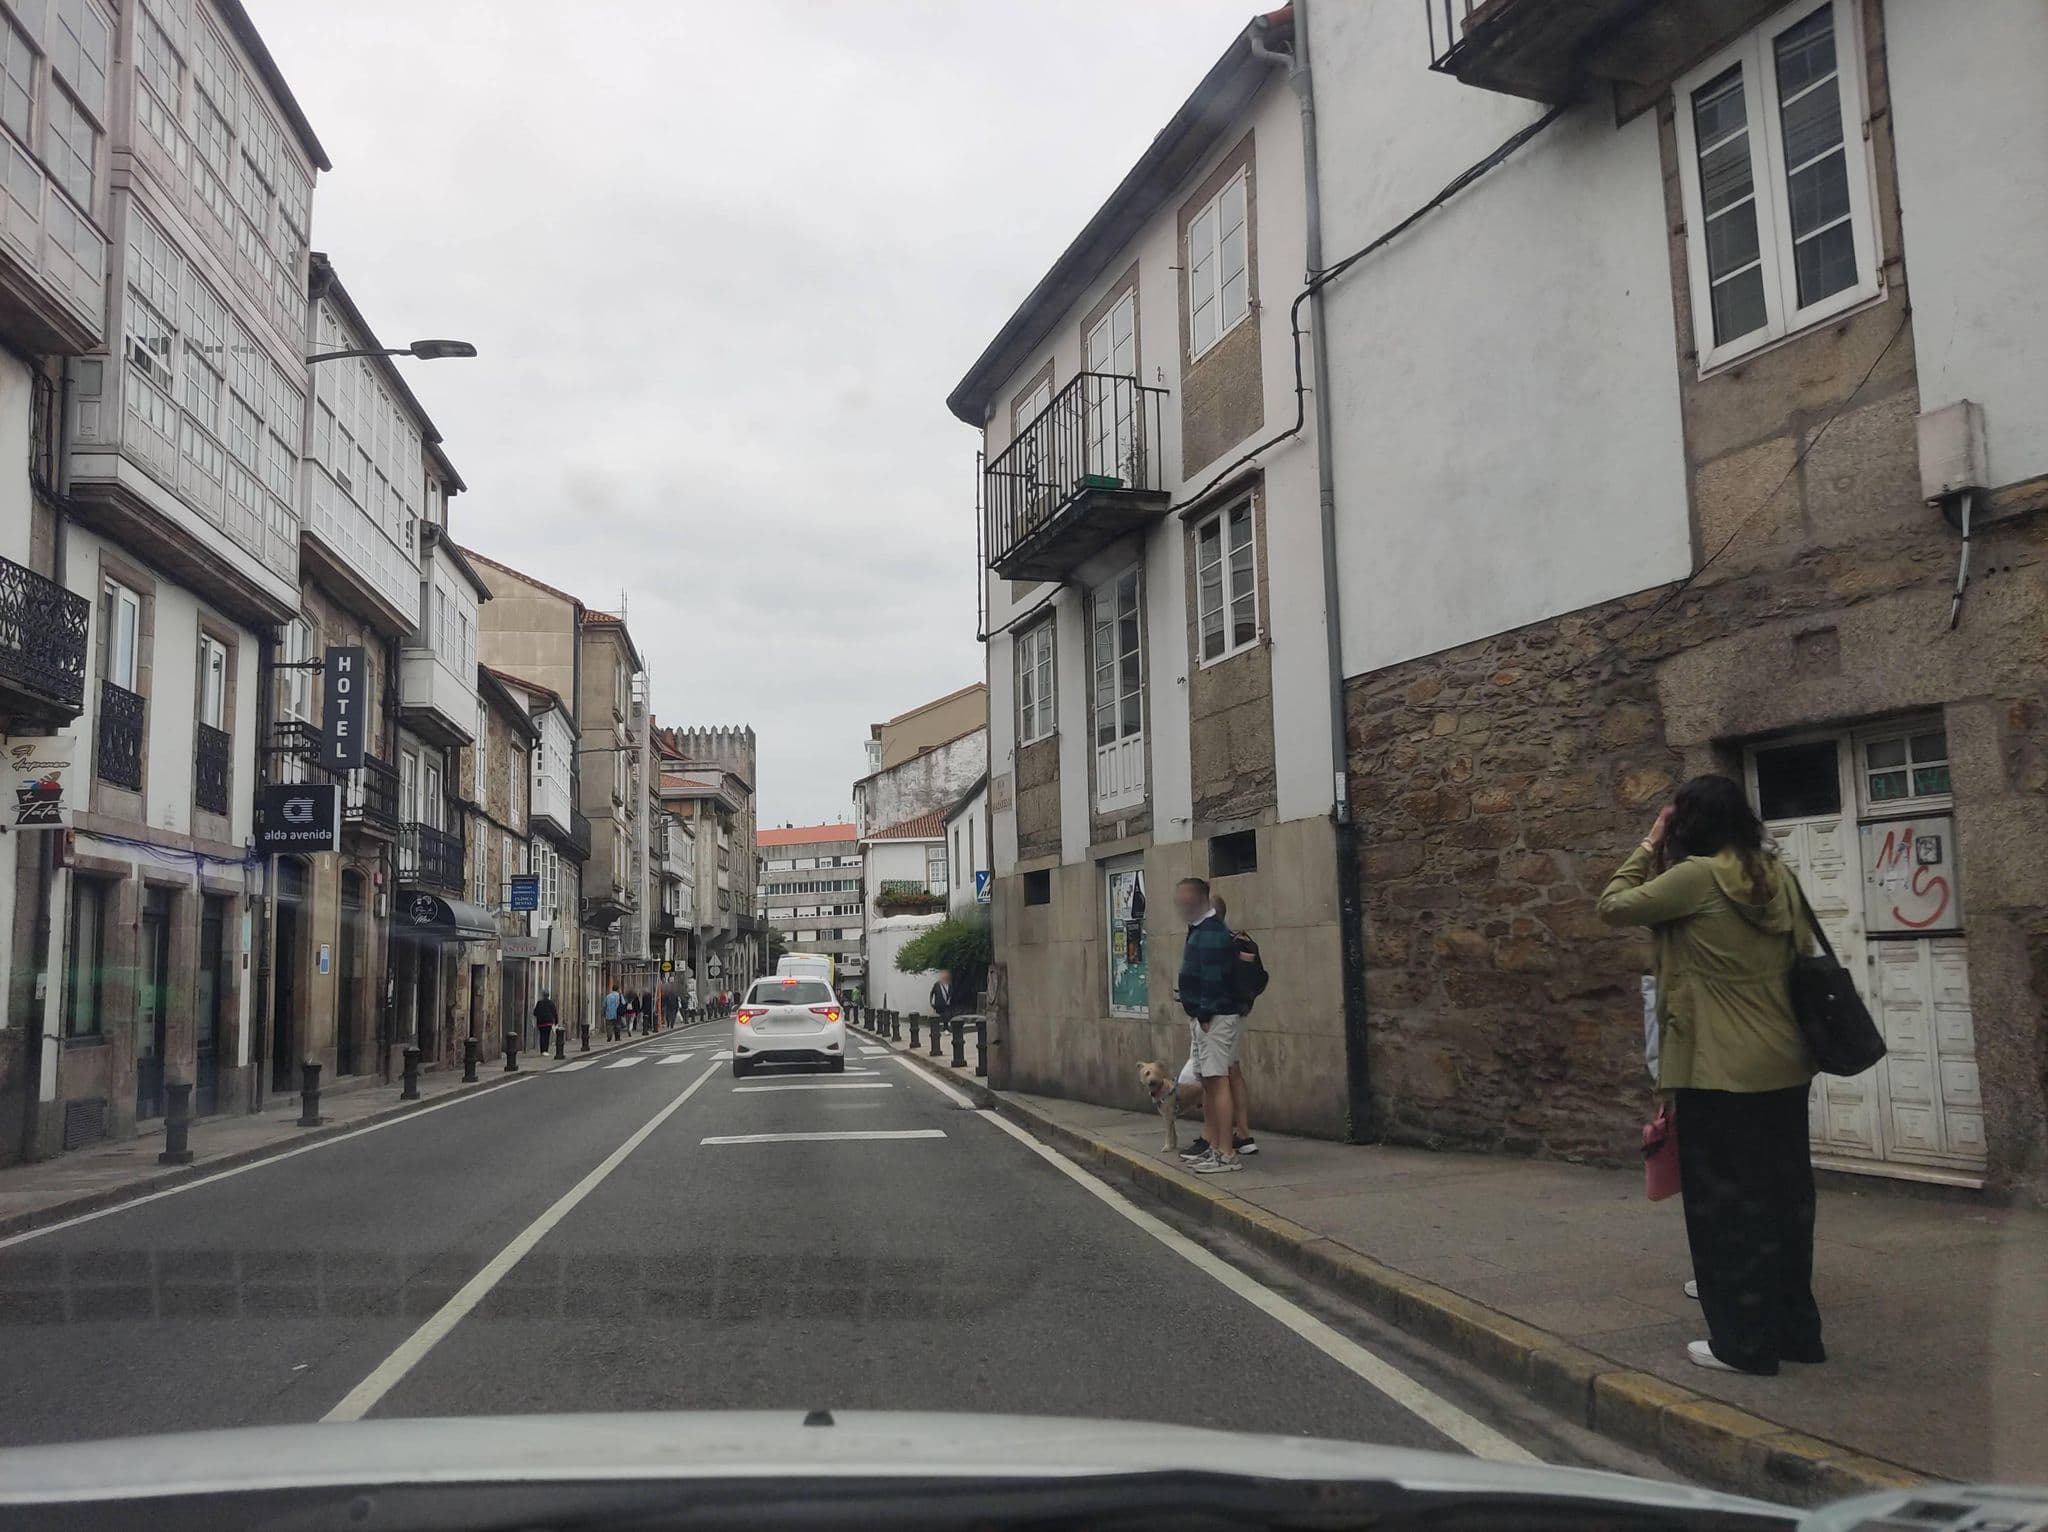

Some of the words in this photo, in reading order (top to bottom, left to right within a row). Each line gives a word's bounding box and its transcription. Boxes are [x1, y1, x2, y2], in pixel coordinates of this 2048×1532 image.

[336, 656, 352, 758] HOTEL
[264, 829, 287, 840] alda
[290, 828, 333, 840] avenida
